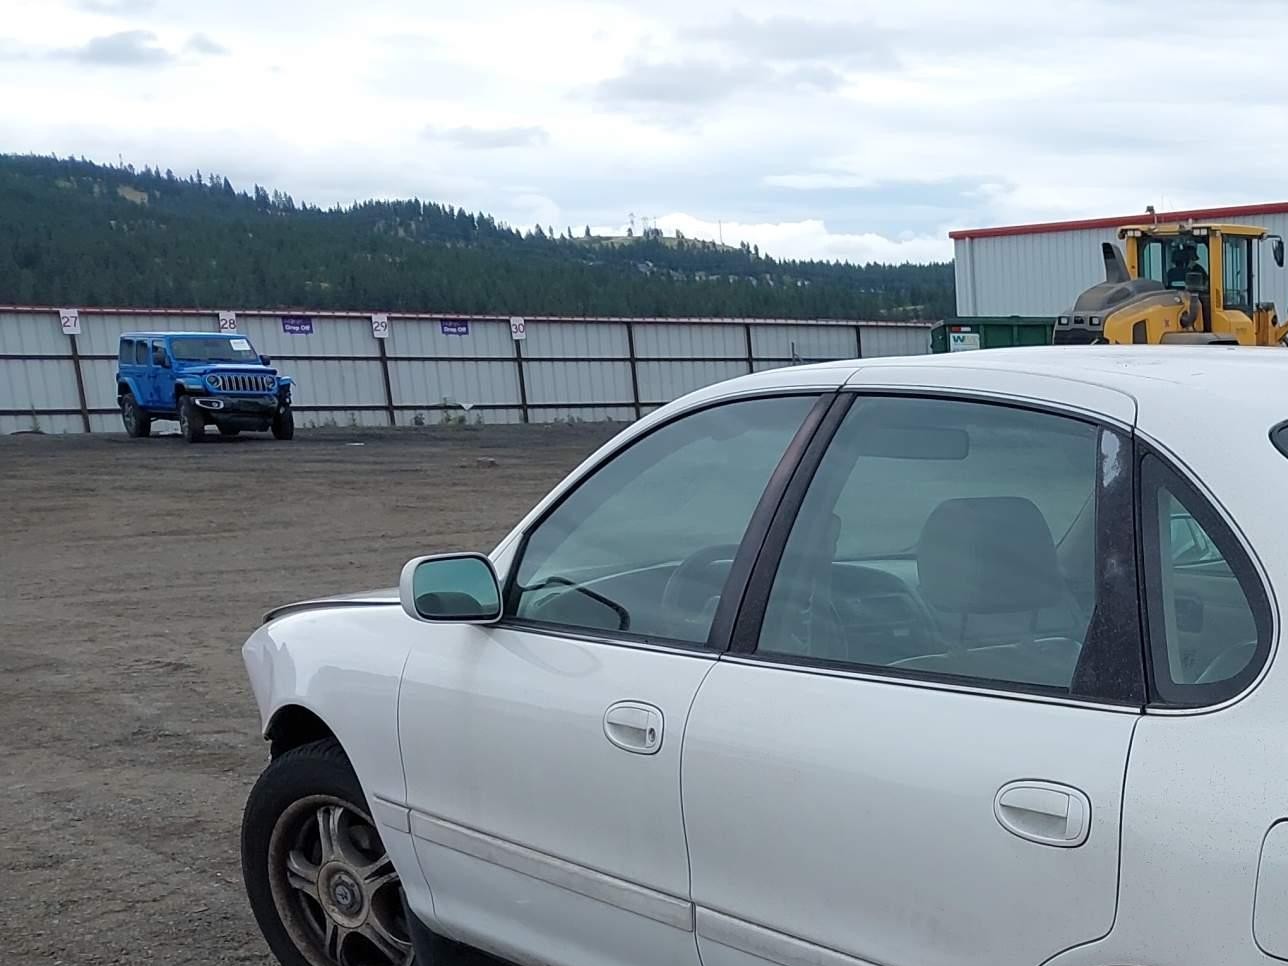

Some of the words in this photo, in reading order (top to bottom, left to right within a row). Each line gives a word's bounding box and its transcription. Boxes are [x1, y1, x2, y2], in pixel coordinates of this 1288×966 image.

[61, 315, 78, 328] 27
[220, 317, 237, 330] 28
[373, 320, 388, 332] 29
[512, 322, 525, 334] 30
